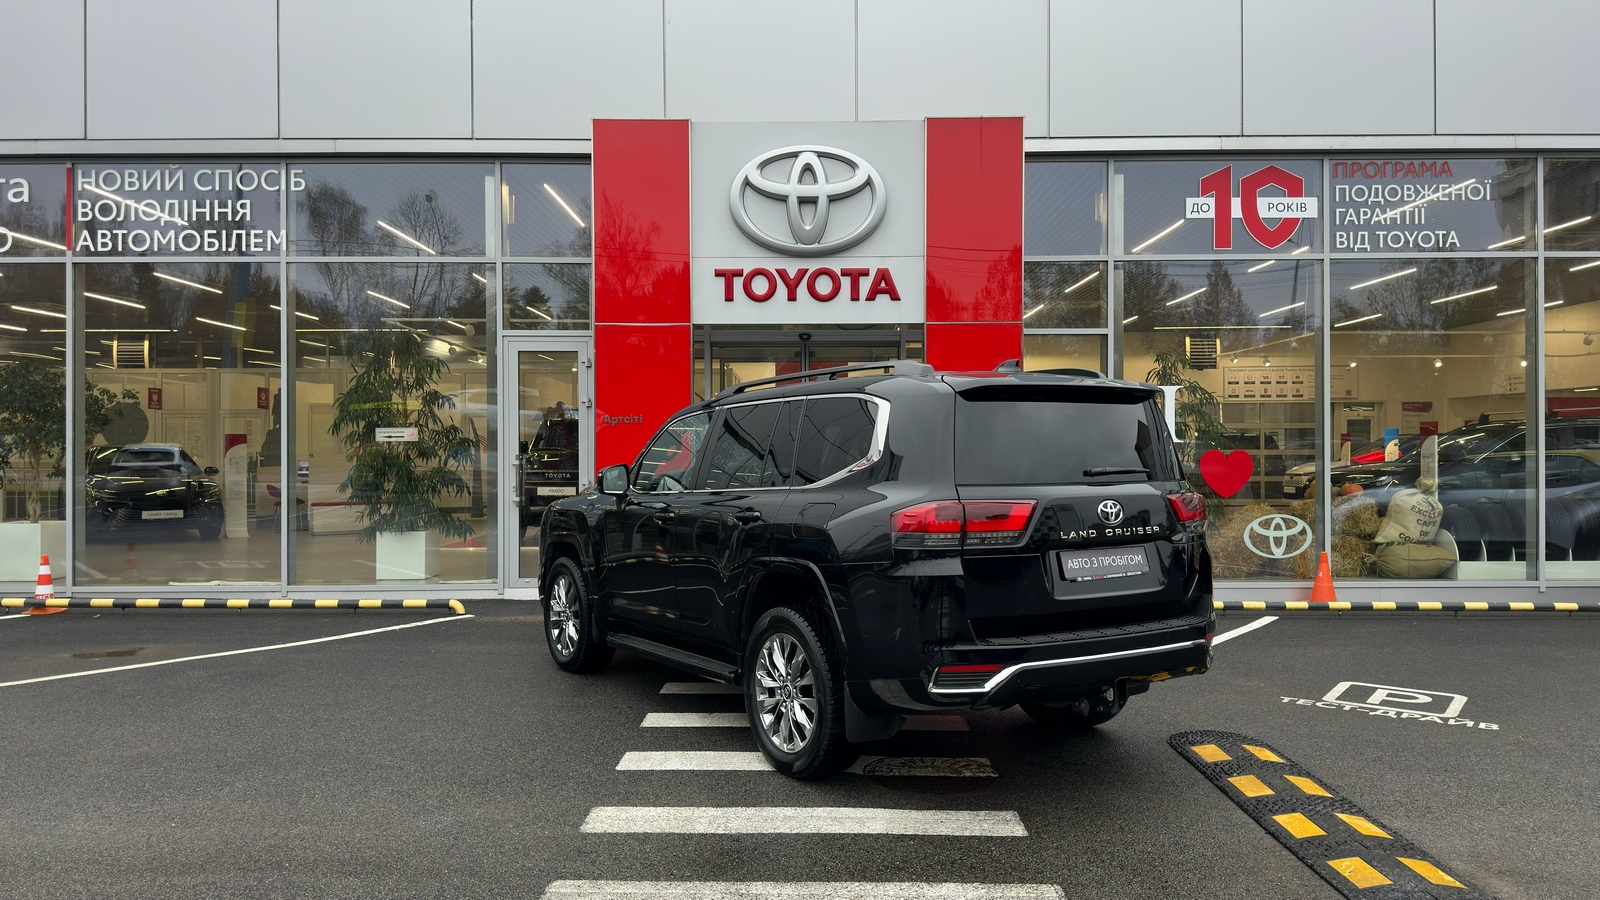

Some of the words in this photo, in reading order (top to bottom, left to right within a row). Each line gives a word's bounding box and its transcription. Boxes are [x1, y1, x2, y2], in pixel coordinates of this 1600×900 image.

[77, 164, 185, 191] НОВИЙ
[193, 168, 306, 191] СПОСІБ
[1333, 160, 1454, 180] ПРОГРАМА
[1335, 179, 1493, 205] ПОДОВЖЕНОЇ
[77, 199, 251, 226] ВОЛОДІННЯ
[1190, 202, 1211, 215] ДО
[1200, 164, 1304, 249] 10
[1266, 201, 1308, 214] РОКІВ
[1335, 204, 1427, 226] ГАРАНТІЇ
[75, 228, 287, 252] АВТОМОБІЛЕМ
[1335, 231, 1372, 252] ВІД
[1375, 230, 1461, 249] TOYOTA
[714, 266, 902, 303] TOYOTA
[603, 413, 643, 427] Артсіті
[1059, 529, 1098, 540] LAND
[1104, 525, 1161, 537] CRUISER
[1067, 557, 1091, 569] АВТО
[1098, 554, 1144, 567] ПРОБІГОМ
[1279, 695, 1500, 731] ТЕСТ-ДРАЙВ
